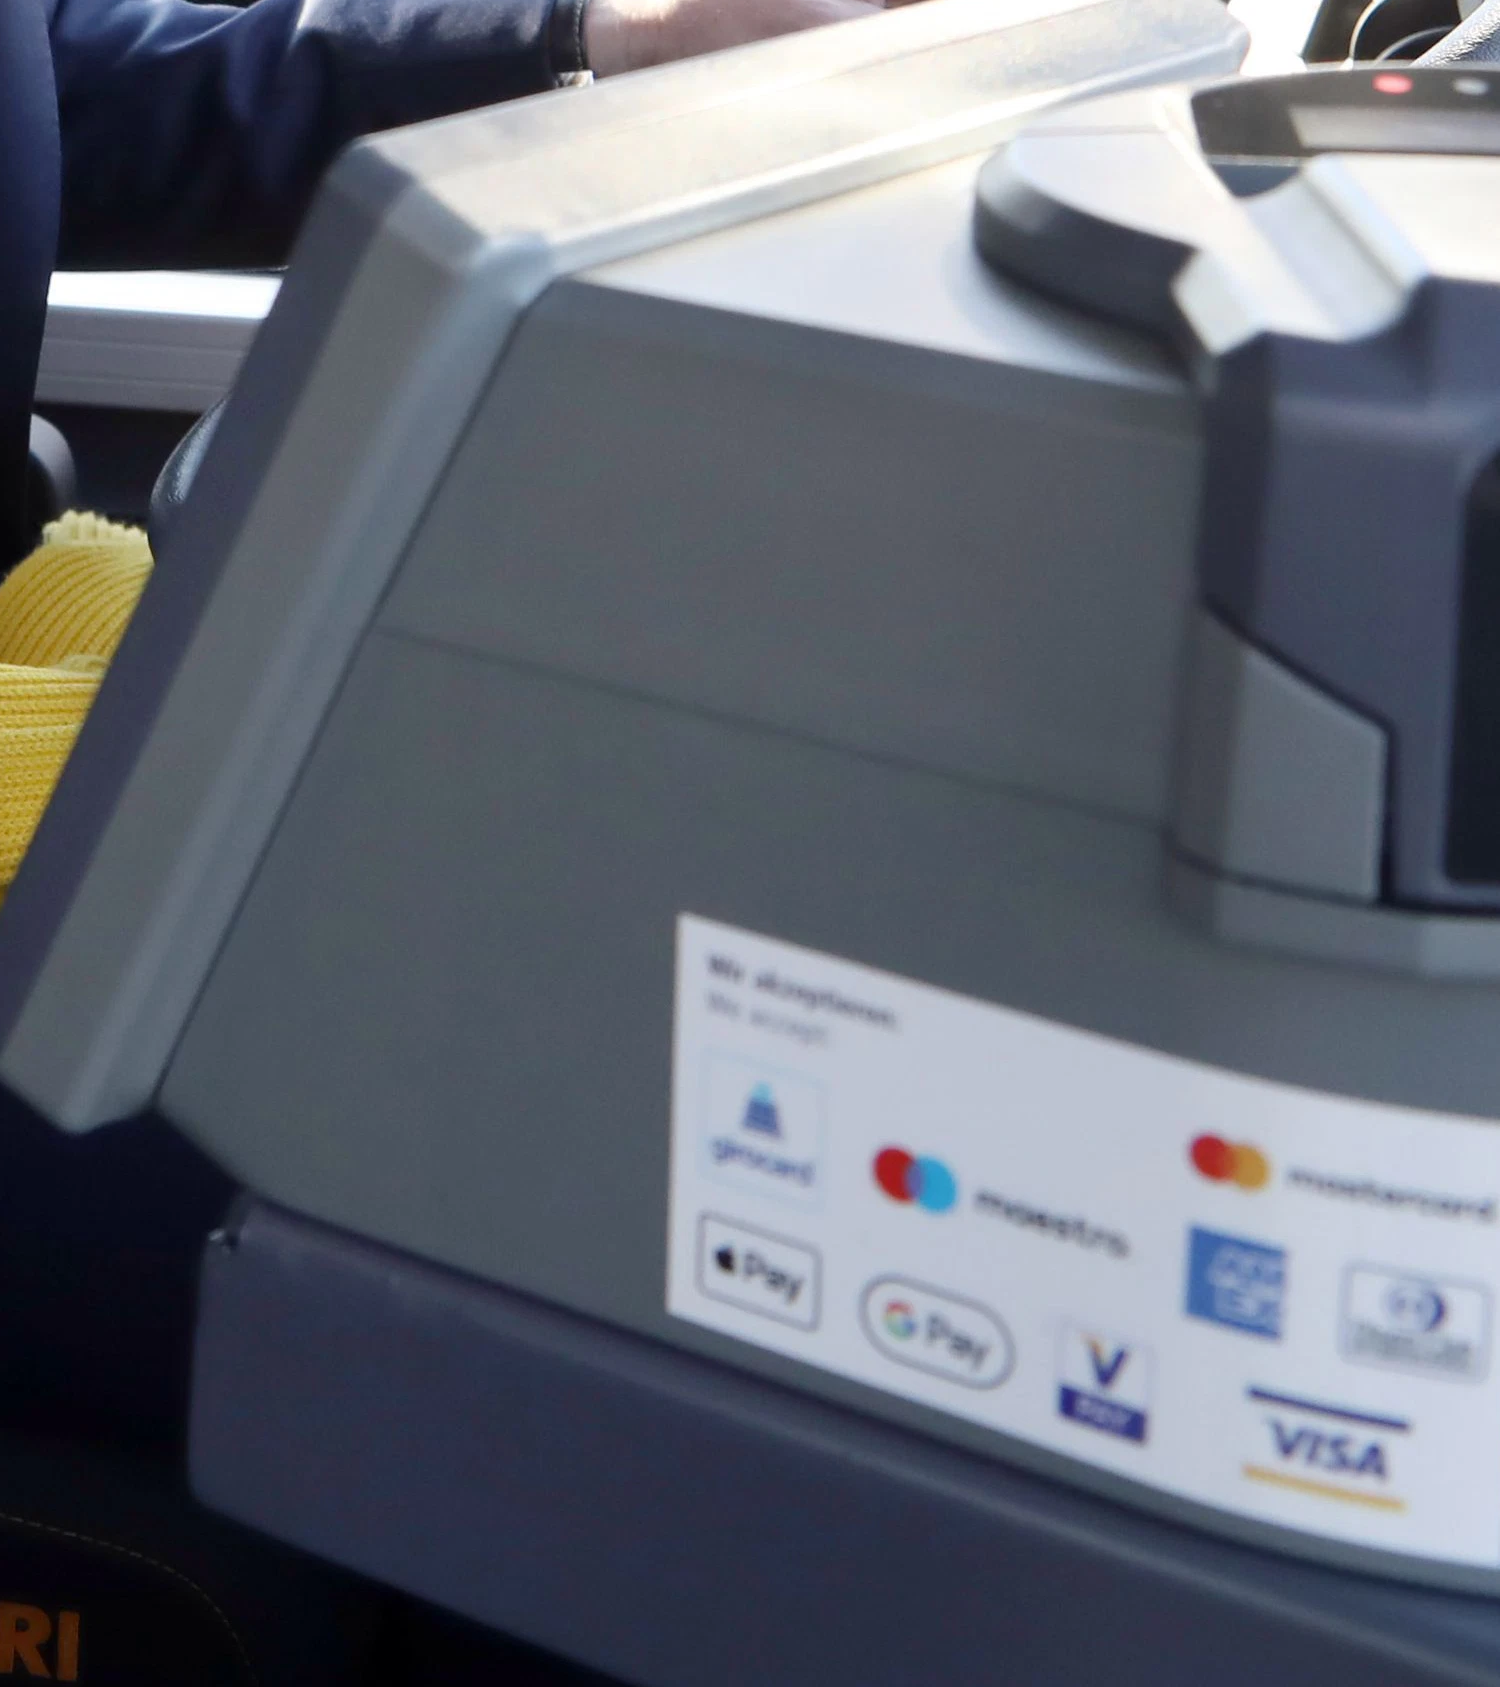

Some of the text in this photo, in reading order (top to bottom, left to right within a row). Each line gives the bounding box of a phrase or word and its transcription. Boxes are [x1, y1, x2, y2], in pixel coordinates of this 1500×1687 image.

[712, 1135, 815, 1187] girocard
[974, 1186, 1133, 1261] maestro
[1287, 1168, 1497, 1220] mastercard
[743, 1250, 805, 1305] Pay
[926, 1311, 993, 1374] Pay
[1268, 1415, 1390, 1483] VISA
